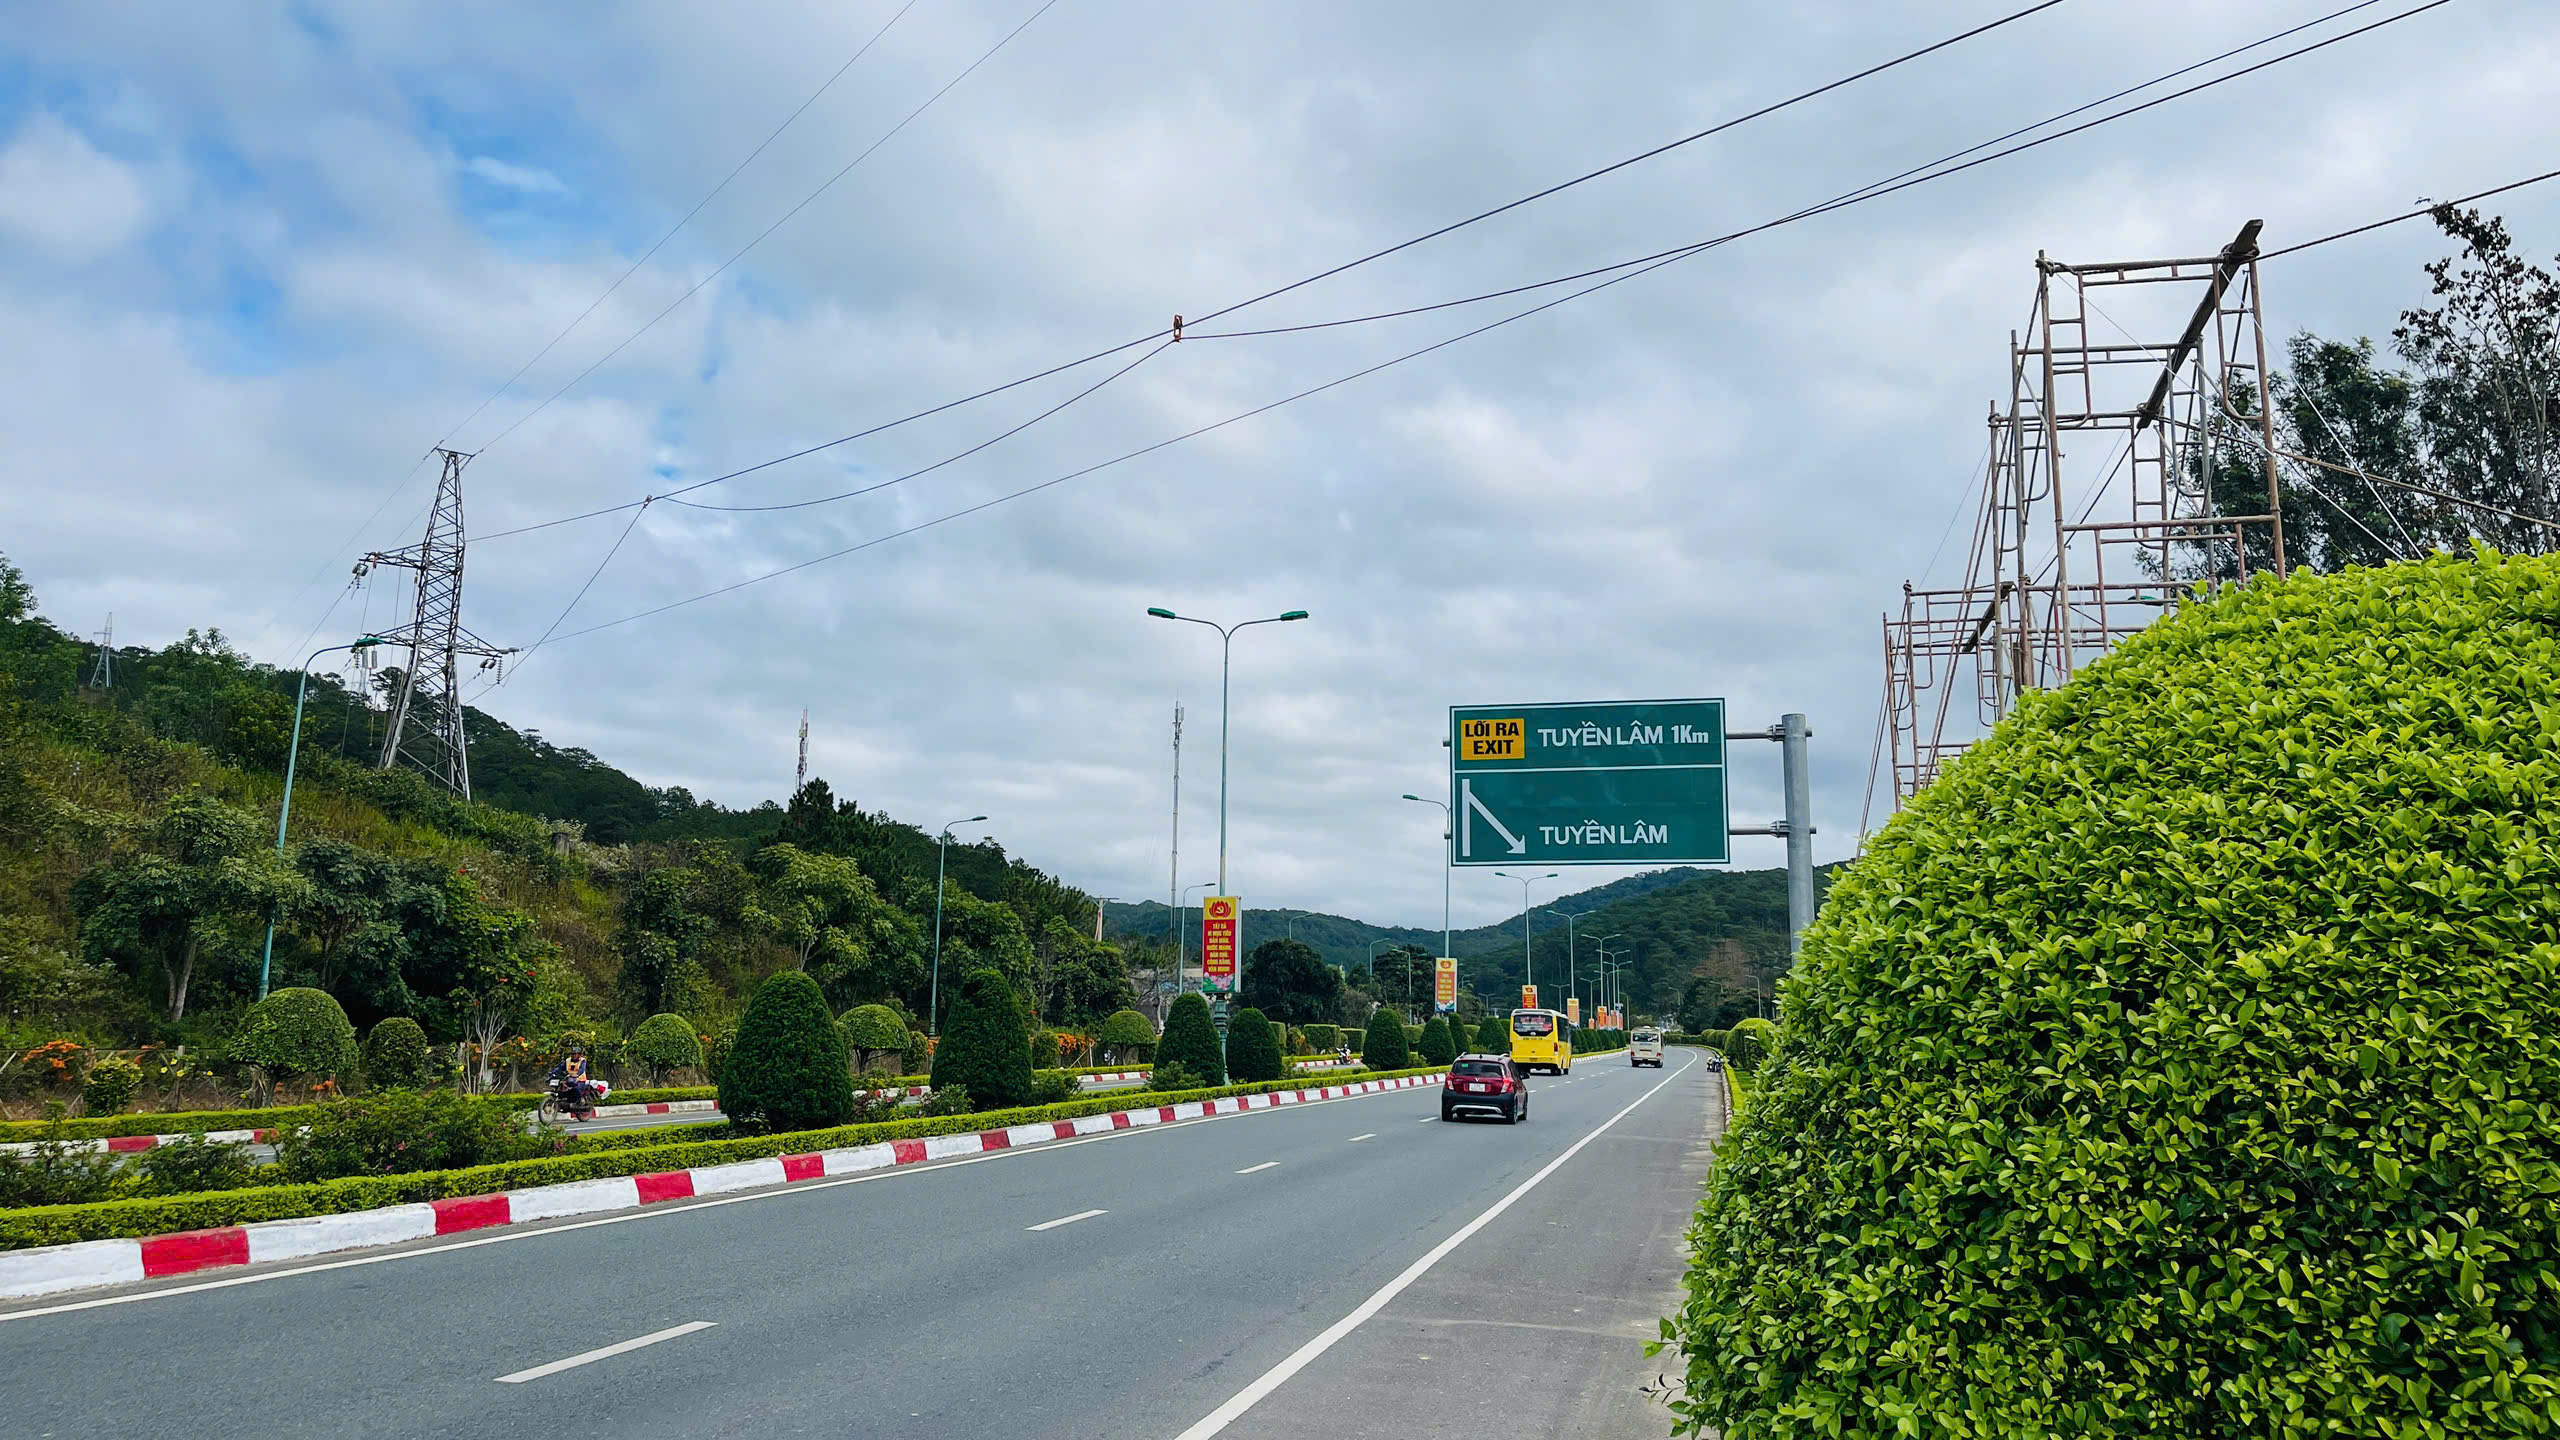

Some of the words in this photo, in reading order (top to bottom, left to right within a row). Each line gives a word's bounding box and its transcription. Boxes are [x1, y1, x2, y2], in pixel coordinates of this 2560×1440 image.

[1465, 720, 1490, 737] LỐI
[1495, 722, 1520, 736] RA
[1537, 720, 1612, 747] TUYỀN
[1616, 719, 1663, 745] LÂM
[1671, 724, 1709, 744] 1Km
[1473, 739, 1514, 755] EXIT
[1539, 819, 1616, 845] TUYỀN
[1620, 819, 1668, 844] LÂM
